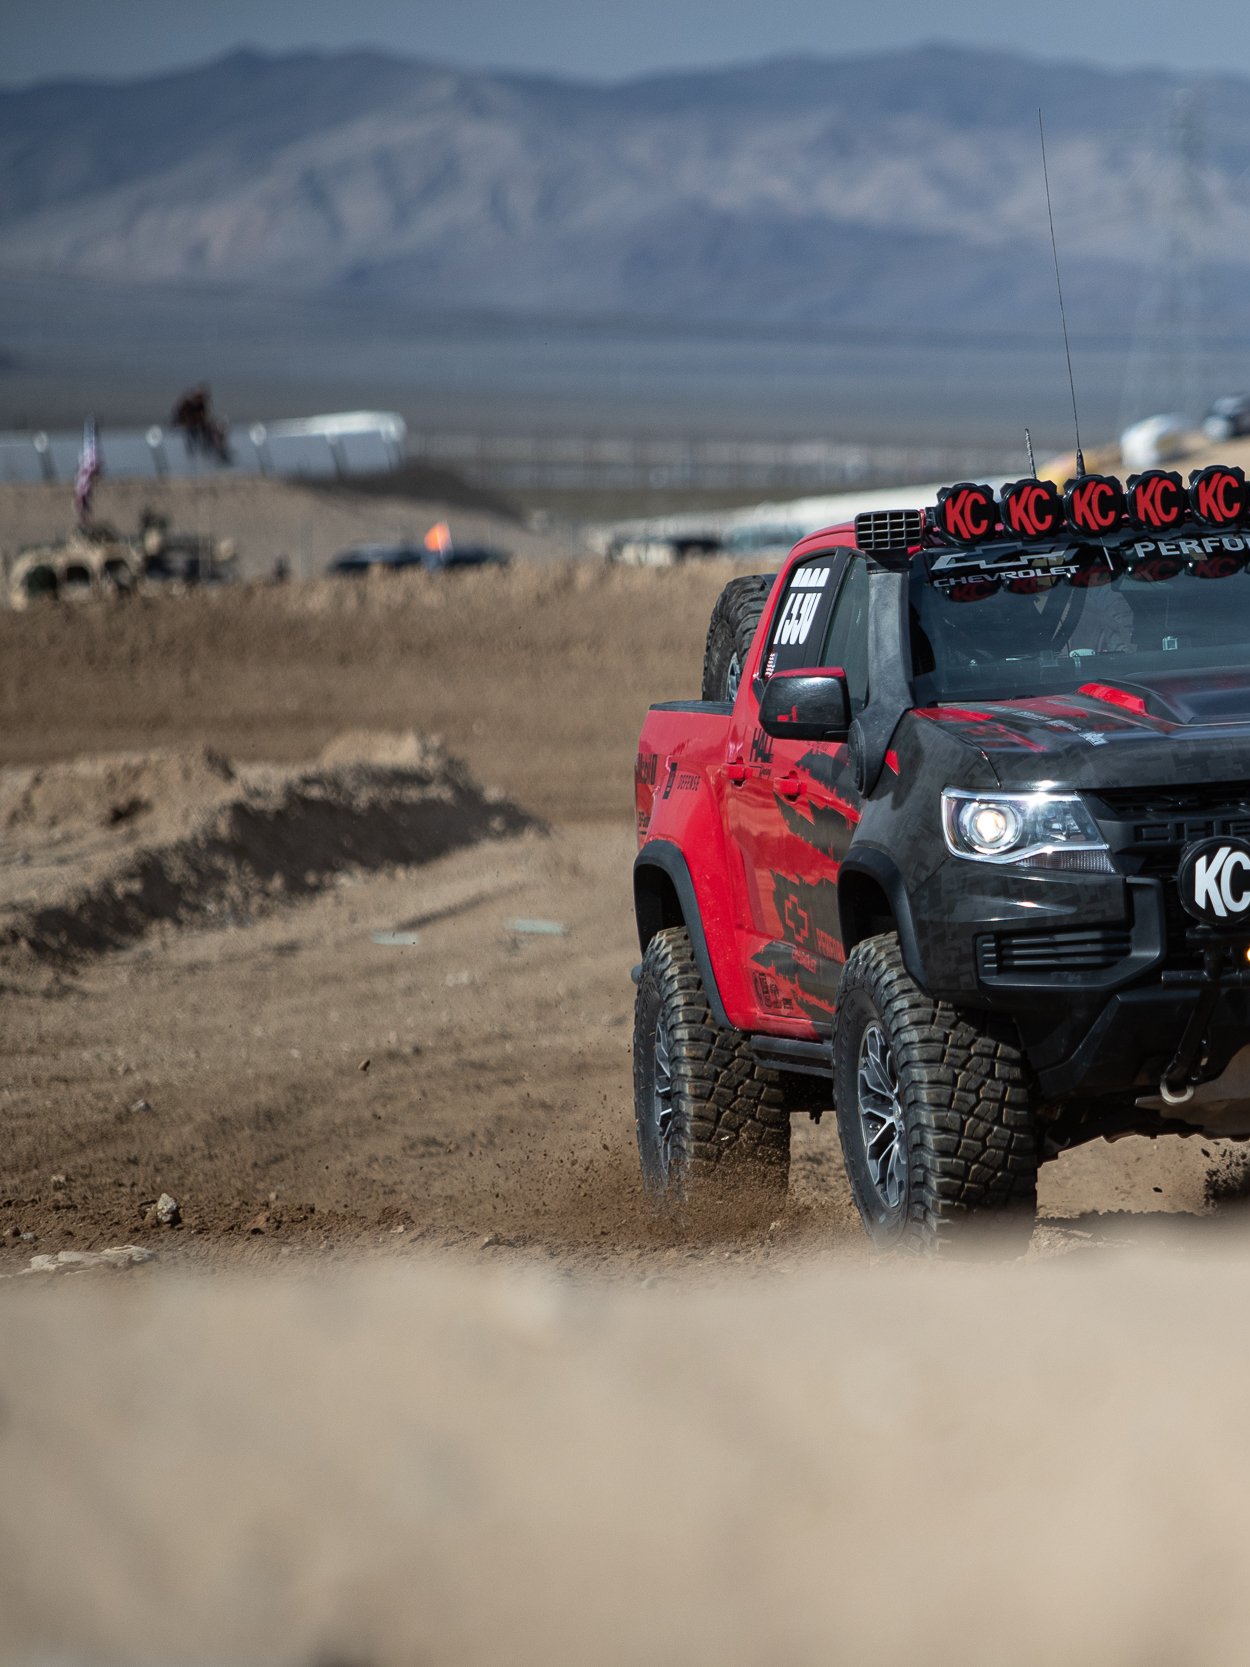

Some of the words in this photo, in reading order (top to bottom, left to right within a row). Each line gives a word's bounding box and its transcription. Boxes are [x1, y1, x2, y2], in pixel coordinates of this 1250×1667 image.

[945, 489, 988, 539] KC
[1009, 485, 1053, 535] KC
[1073, 481, 1116, 531] KC
[1136, 477, 1178, 526] KC
[1198, 472, 1241, 522] KC
[934, 564, 1080, 588] CHEVROLET
